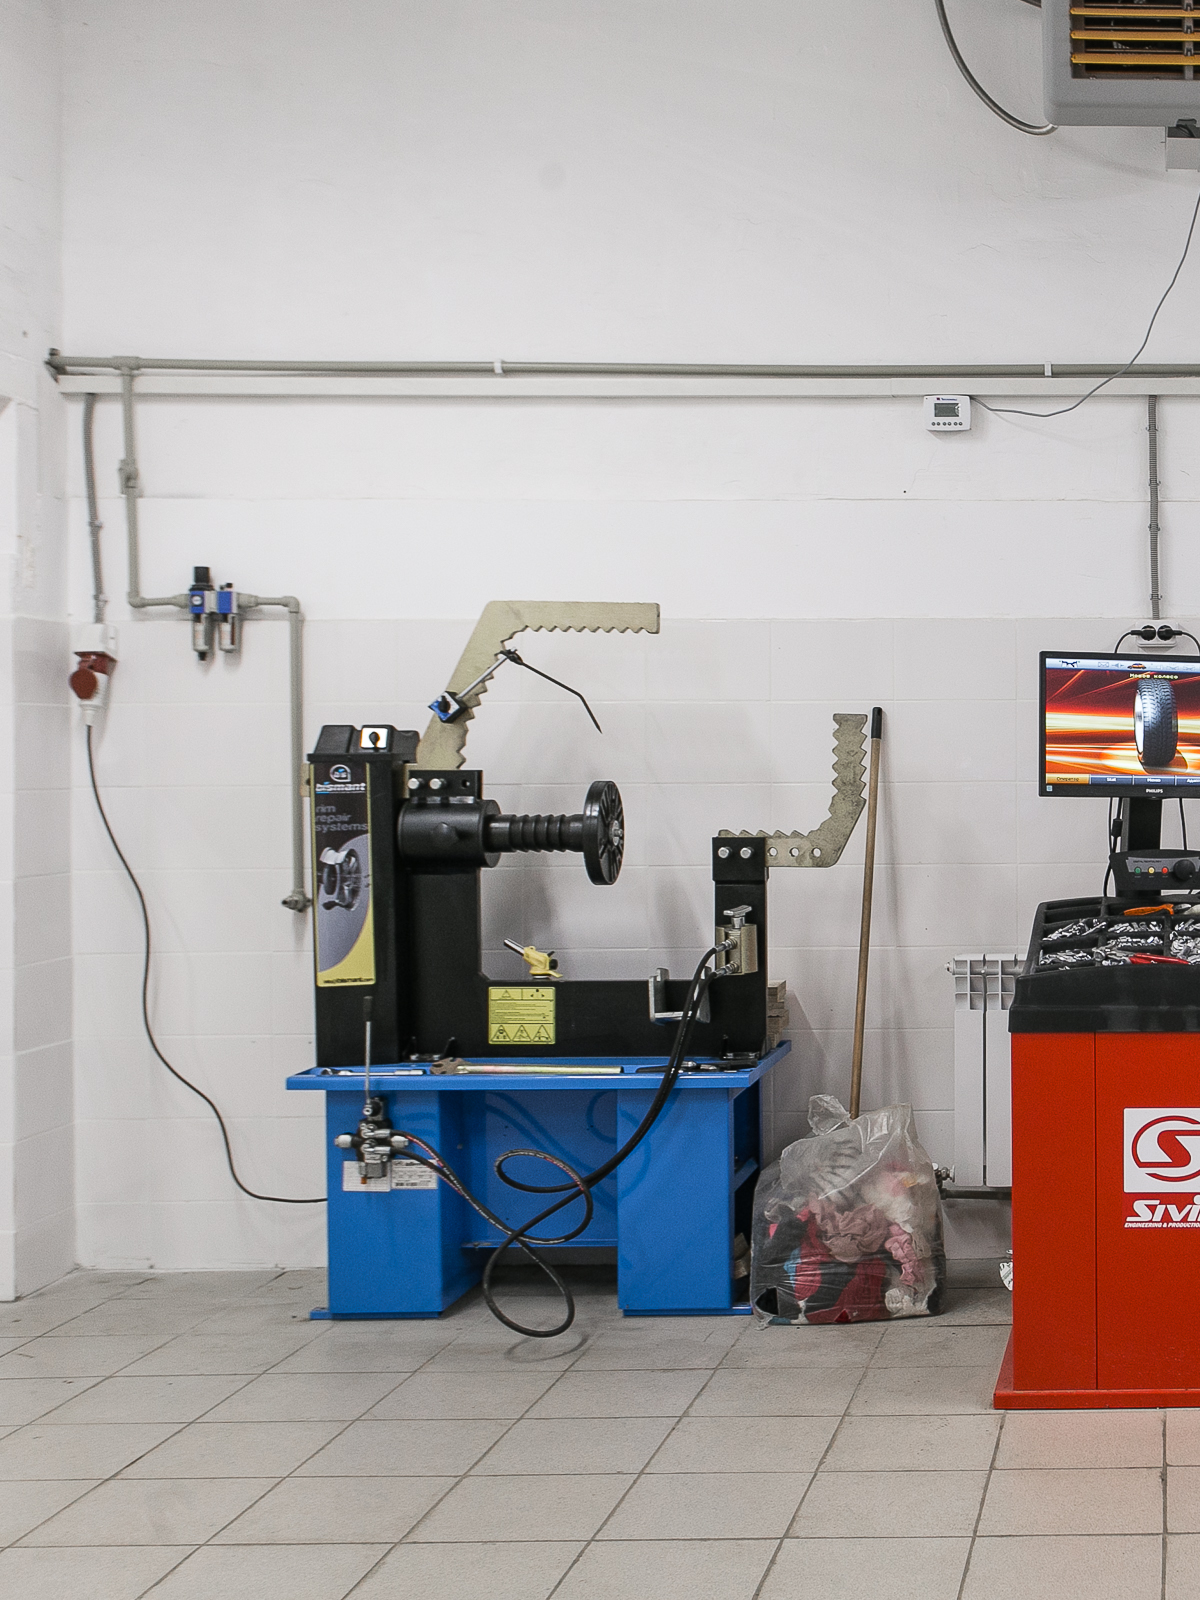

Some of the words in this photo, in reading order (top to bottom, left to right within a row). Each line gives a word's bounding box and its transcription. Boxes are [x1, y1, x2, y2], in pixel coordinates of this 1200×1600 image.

[315, 781, 366, 792] bismant
[316, 804, 336, 813] rim
[315, 813, 351, 824] repair
[315, 823, 368, 833] systems
